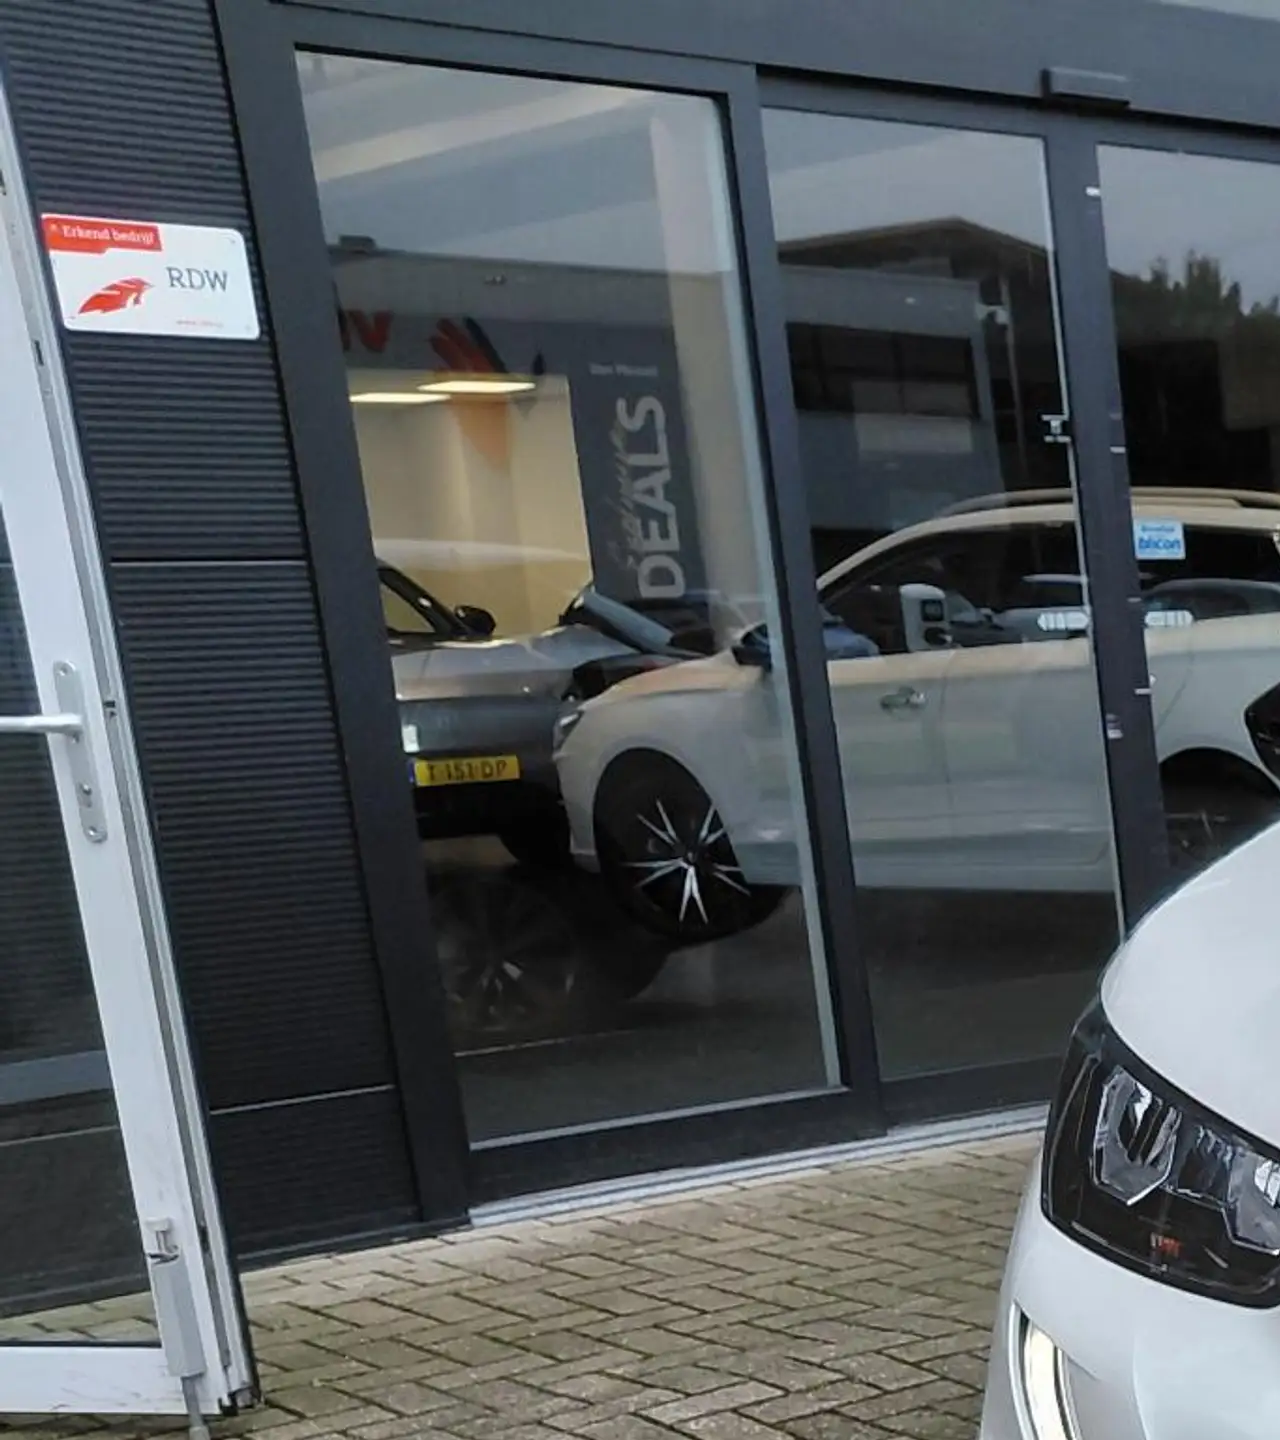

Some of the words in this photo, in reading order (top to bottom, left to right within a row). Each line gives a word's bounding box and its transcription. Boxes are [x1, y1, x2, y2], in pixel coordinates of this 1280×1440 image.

[62, 224, 111, 241] Erkend
[111, 228, 155, 245] bedrijf
[166, 266, 228, 293] RDW
[615, 395, 686, 599] DEALS
